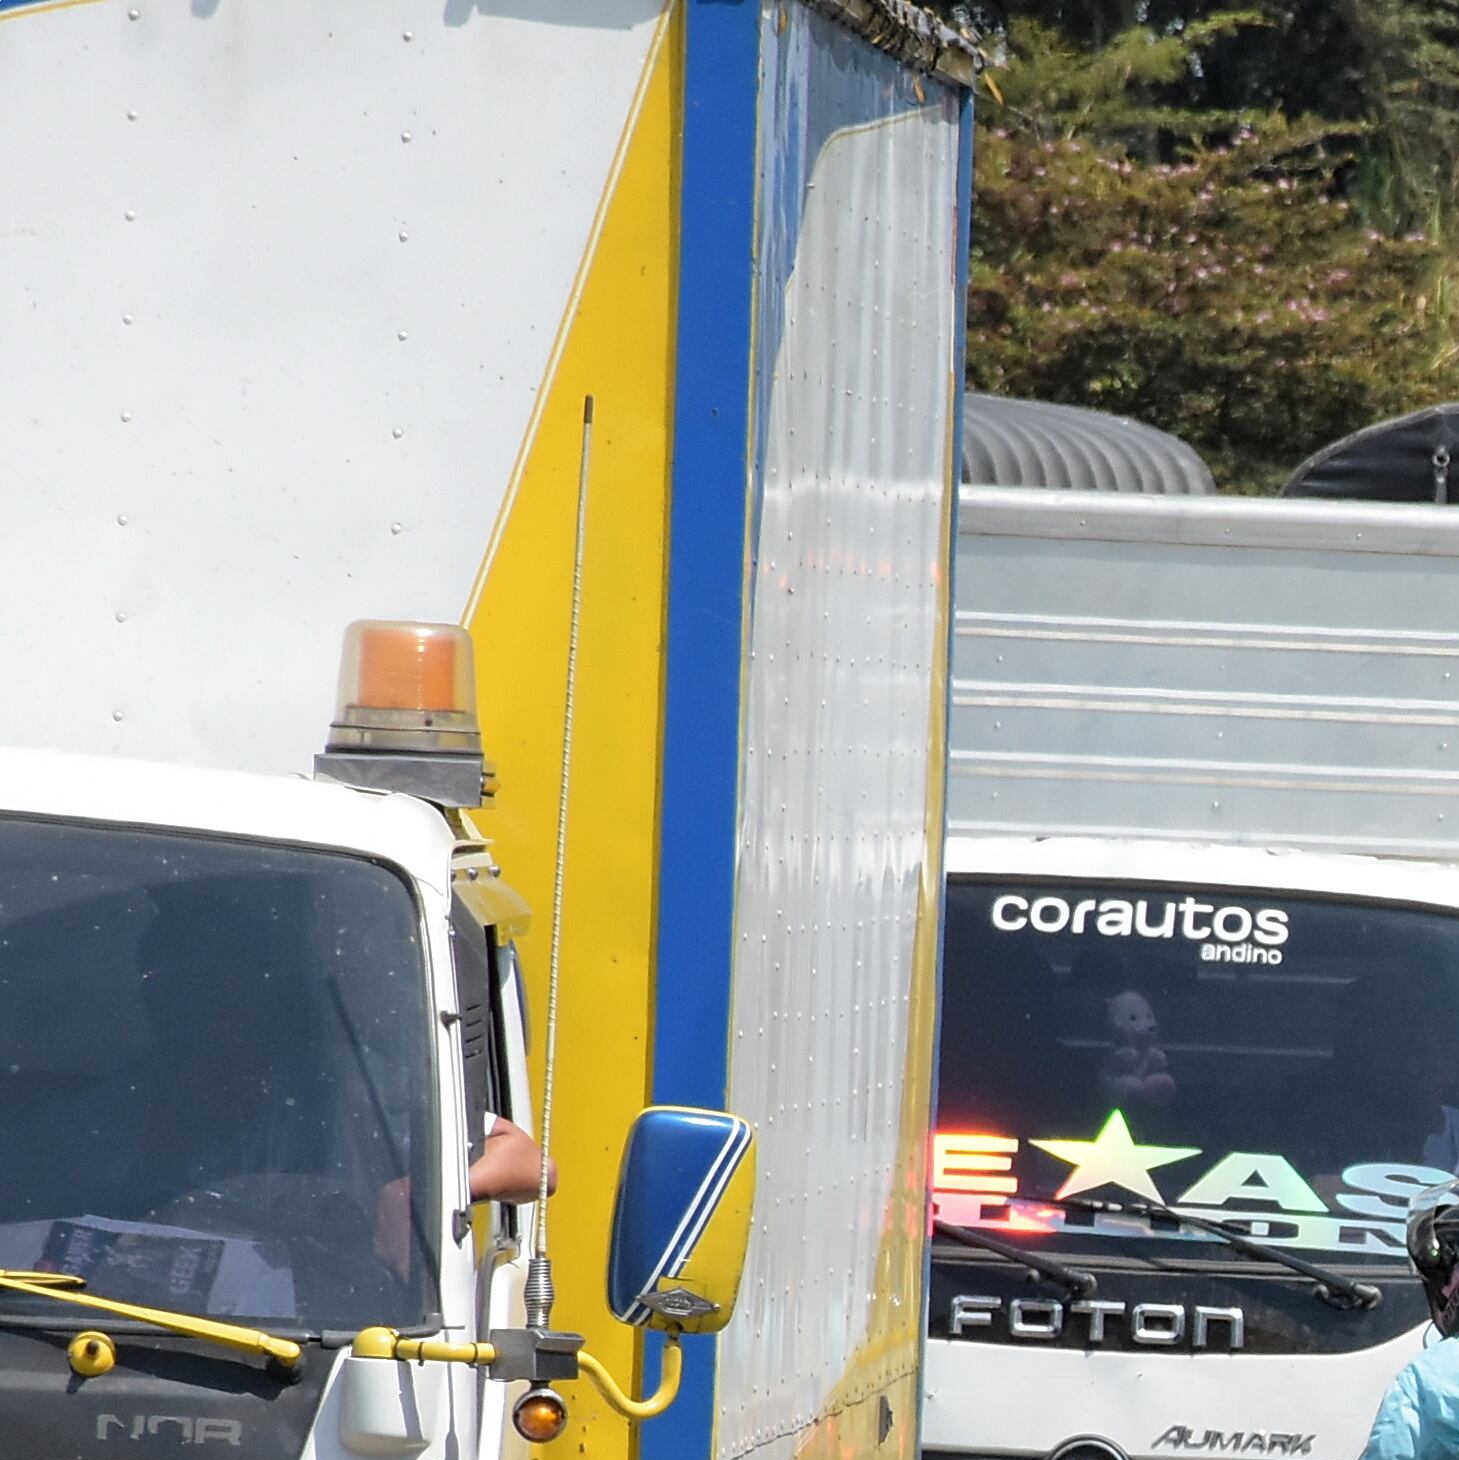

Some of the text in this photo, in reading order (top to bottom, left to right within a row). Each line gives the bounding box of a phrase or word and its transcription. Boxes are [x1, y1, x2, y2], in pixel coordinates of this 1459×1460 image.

[991, 895, 1290, 945] corautos
[1200, 942, 1283, 965] andino
[1151, 1425, 1317, 1456] AUMARK
